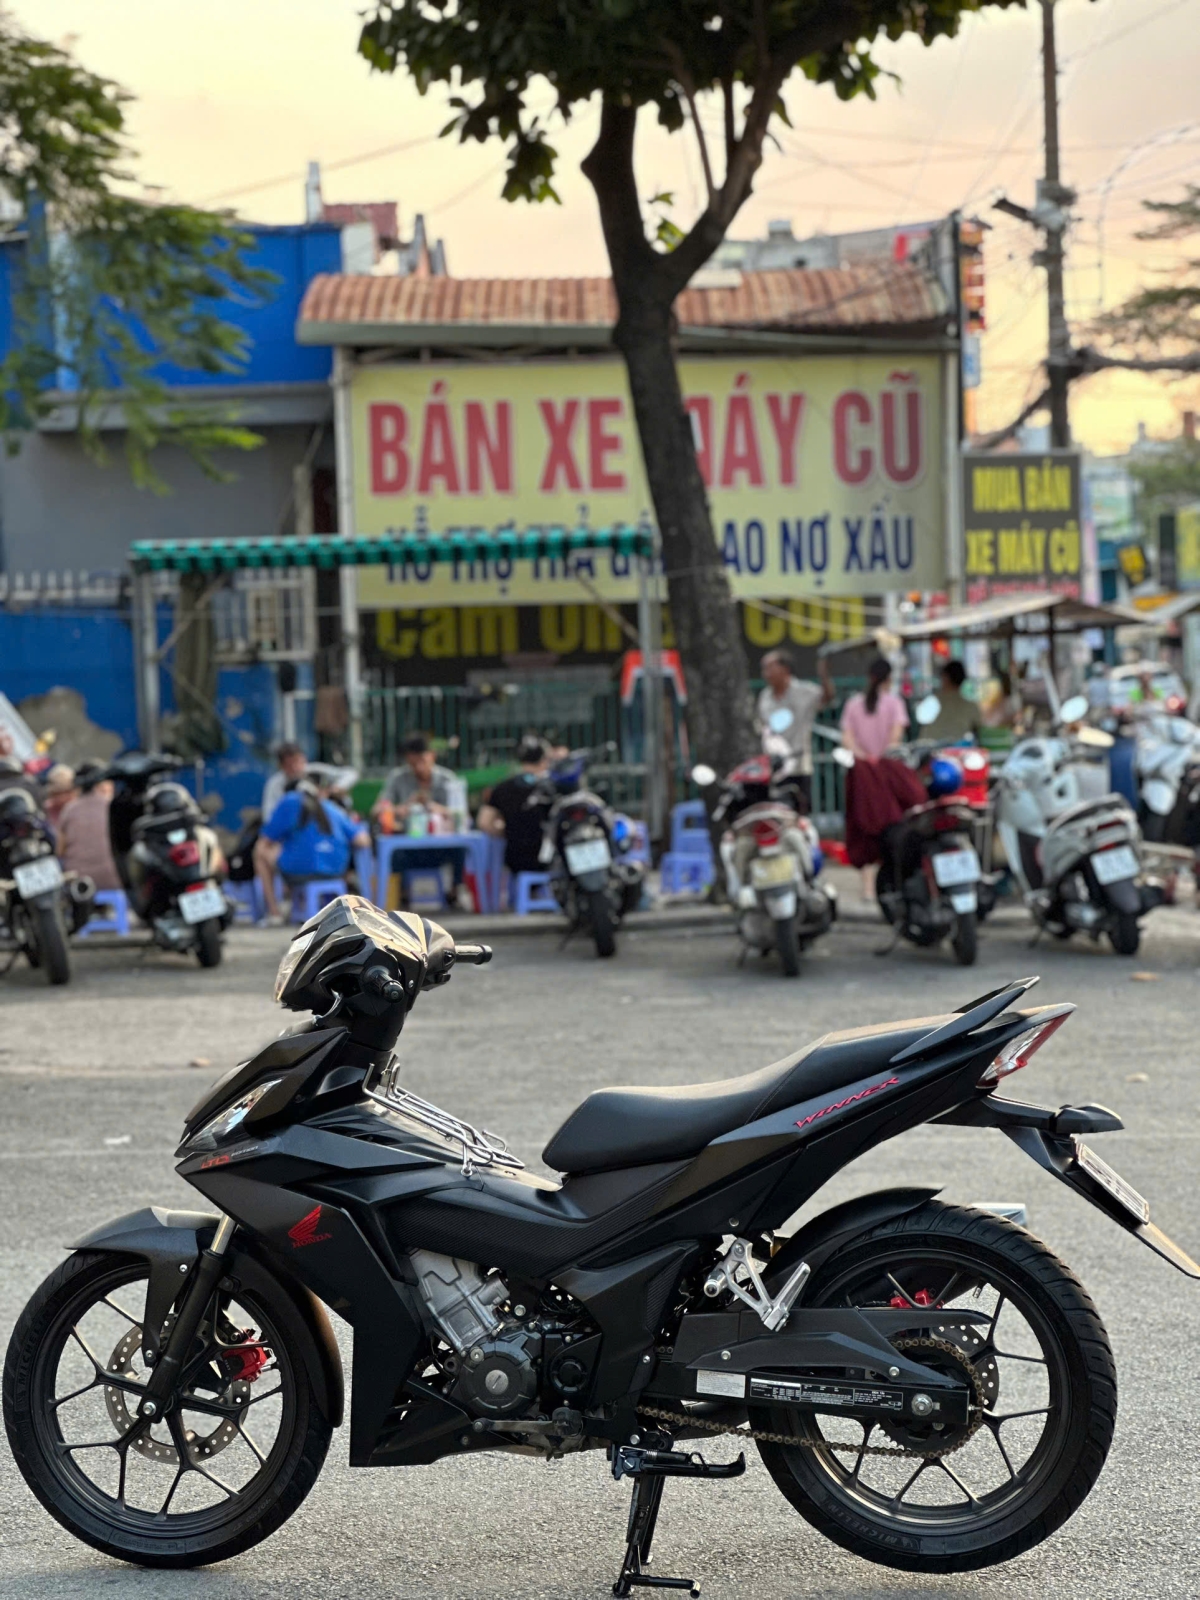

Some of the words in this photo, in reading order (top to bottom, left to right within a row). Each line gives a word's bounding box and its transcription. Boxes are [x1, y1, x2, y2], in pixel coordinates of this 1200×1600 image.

[369, 379, 511, 494] BÁN
[537, 397, 626, 491] XE
[831, 370, 922, 485] CŨ
[971, 465, 1022, 512] MUA
[1023, 458, 1071, 511] BÁN
[720, 520, 764, 575] AO
[780, 511, 830, 588] NỢ
[843, 495, 914, 573] XẤU
[965, 530, 995, 575] XE
[997, 520, 1046, 575] MÁY
[1048, 519, 1081, 575] CŨ
[292, 1232, 334, 1249] HONDA
[826, 1502, 898, 1545] MICHELIN
